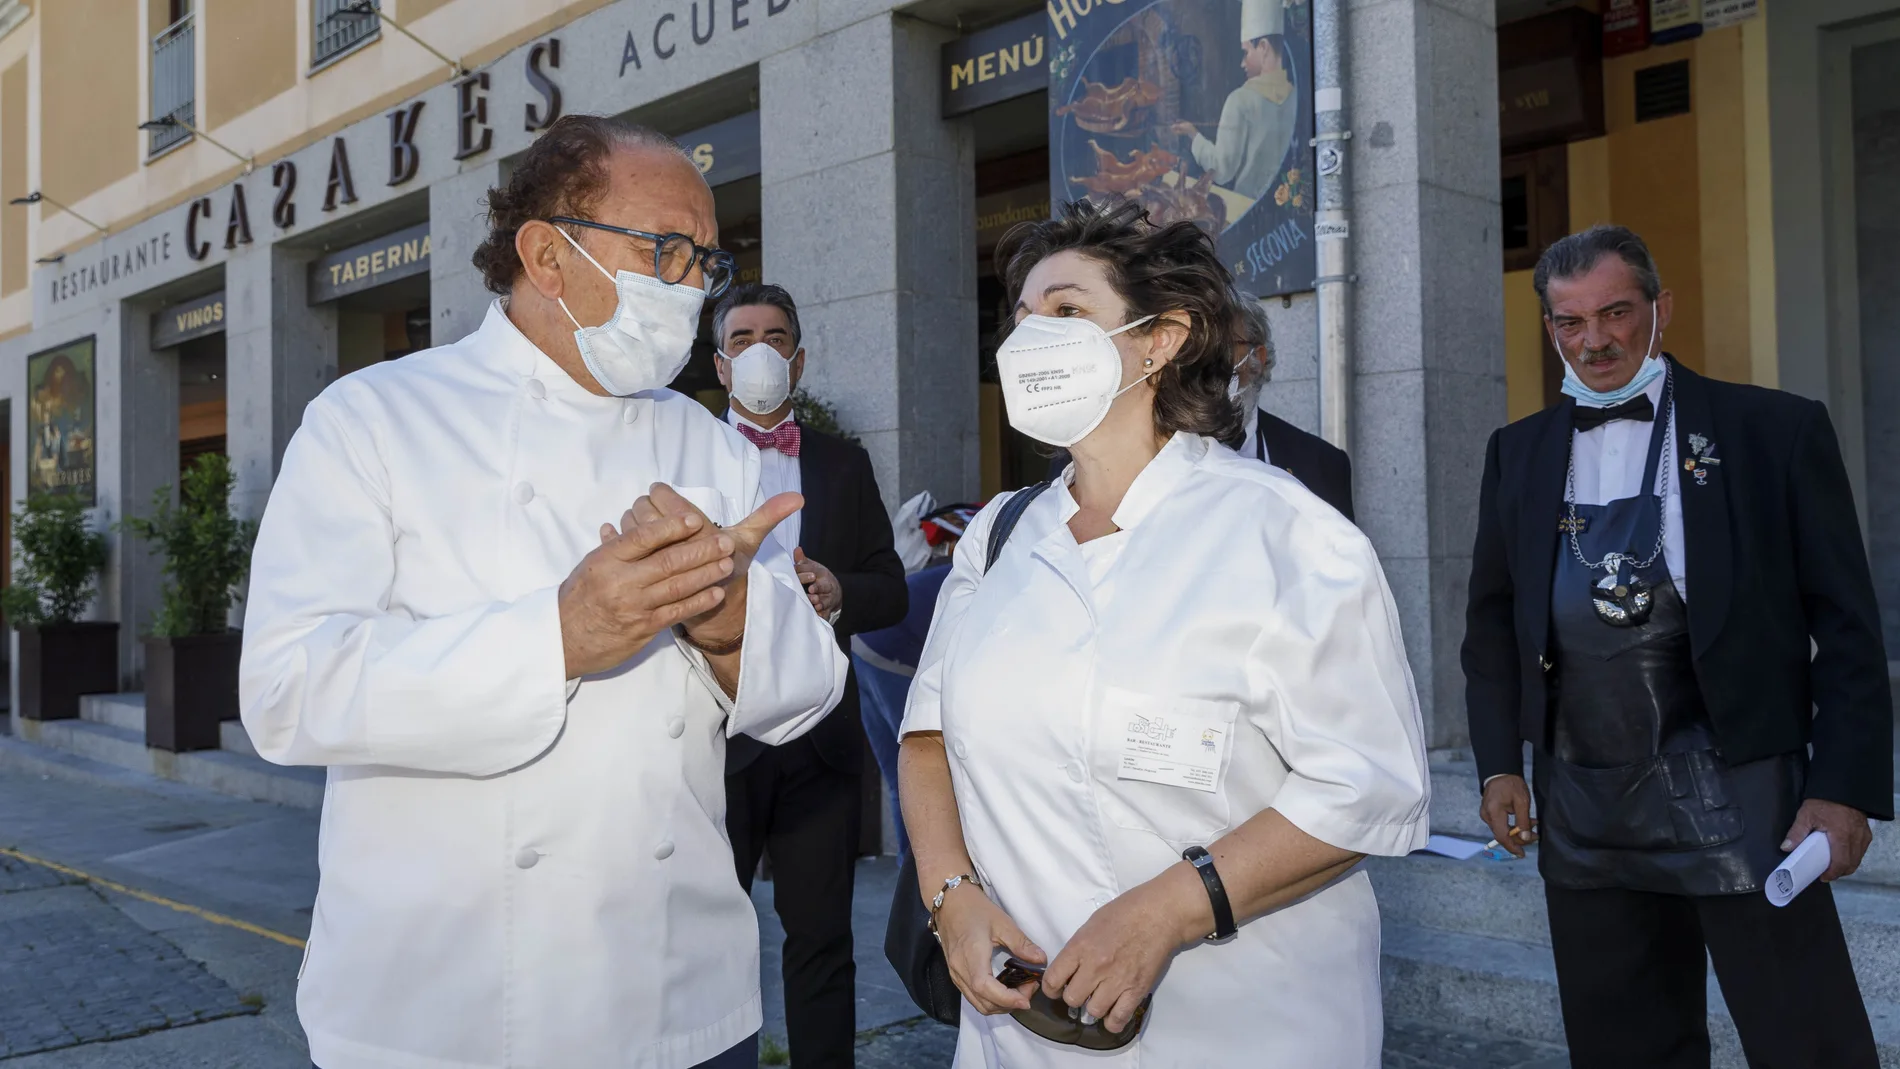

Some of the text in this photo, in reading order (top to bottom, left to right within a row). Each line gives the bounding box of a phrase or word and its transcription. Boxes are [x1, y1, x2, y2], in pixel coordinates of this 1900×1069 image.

[950, 33, 1044, 91] MENÚ
[52, 231, 172, 305] RESTAURANTE
[185, 37, 564, 262] CASARES
[329, 234, 431, 287] TABERNA
[1245, 217, 1308, 283] SEGOVIA
[175, 300, 224, 333] VINOS
